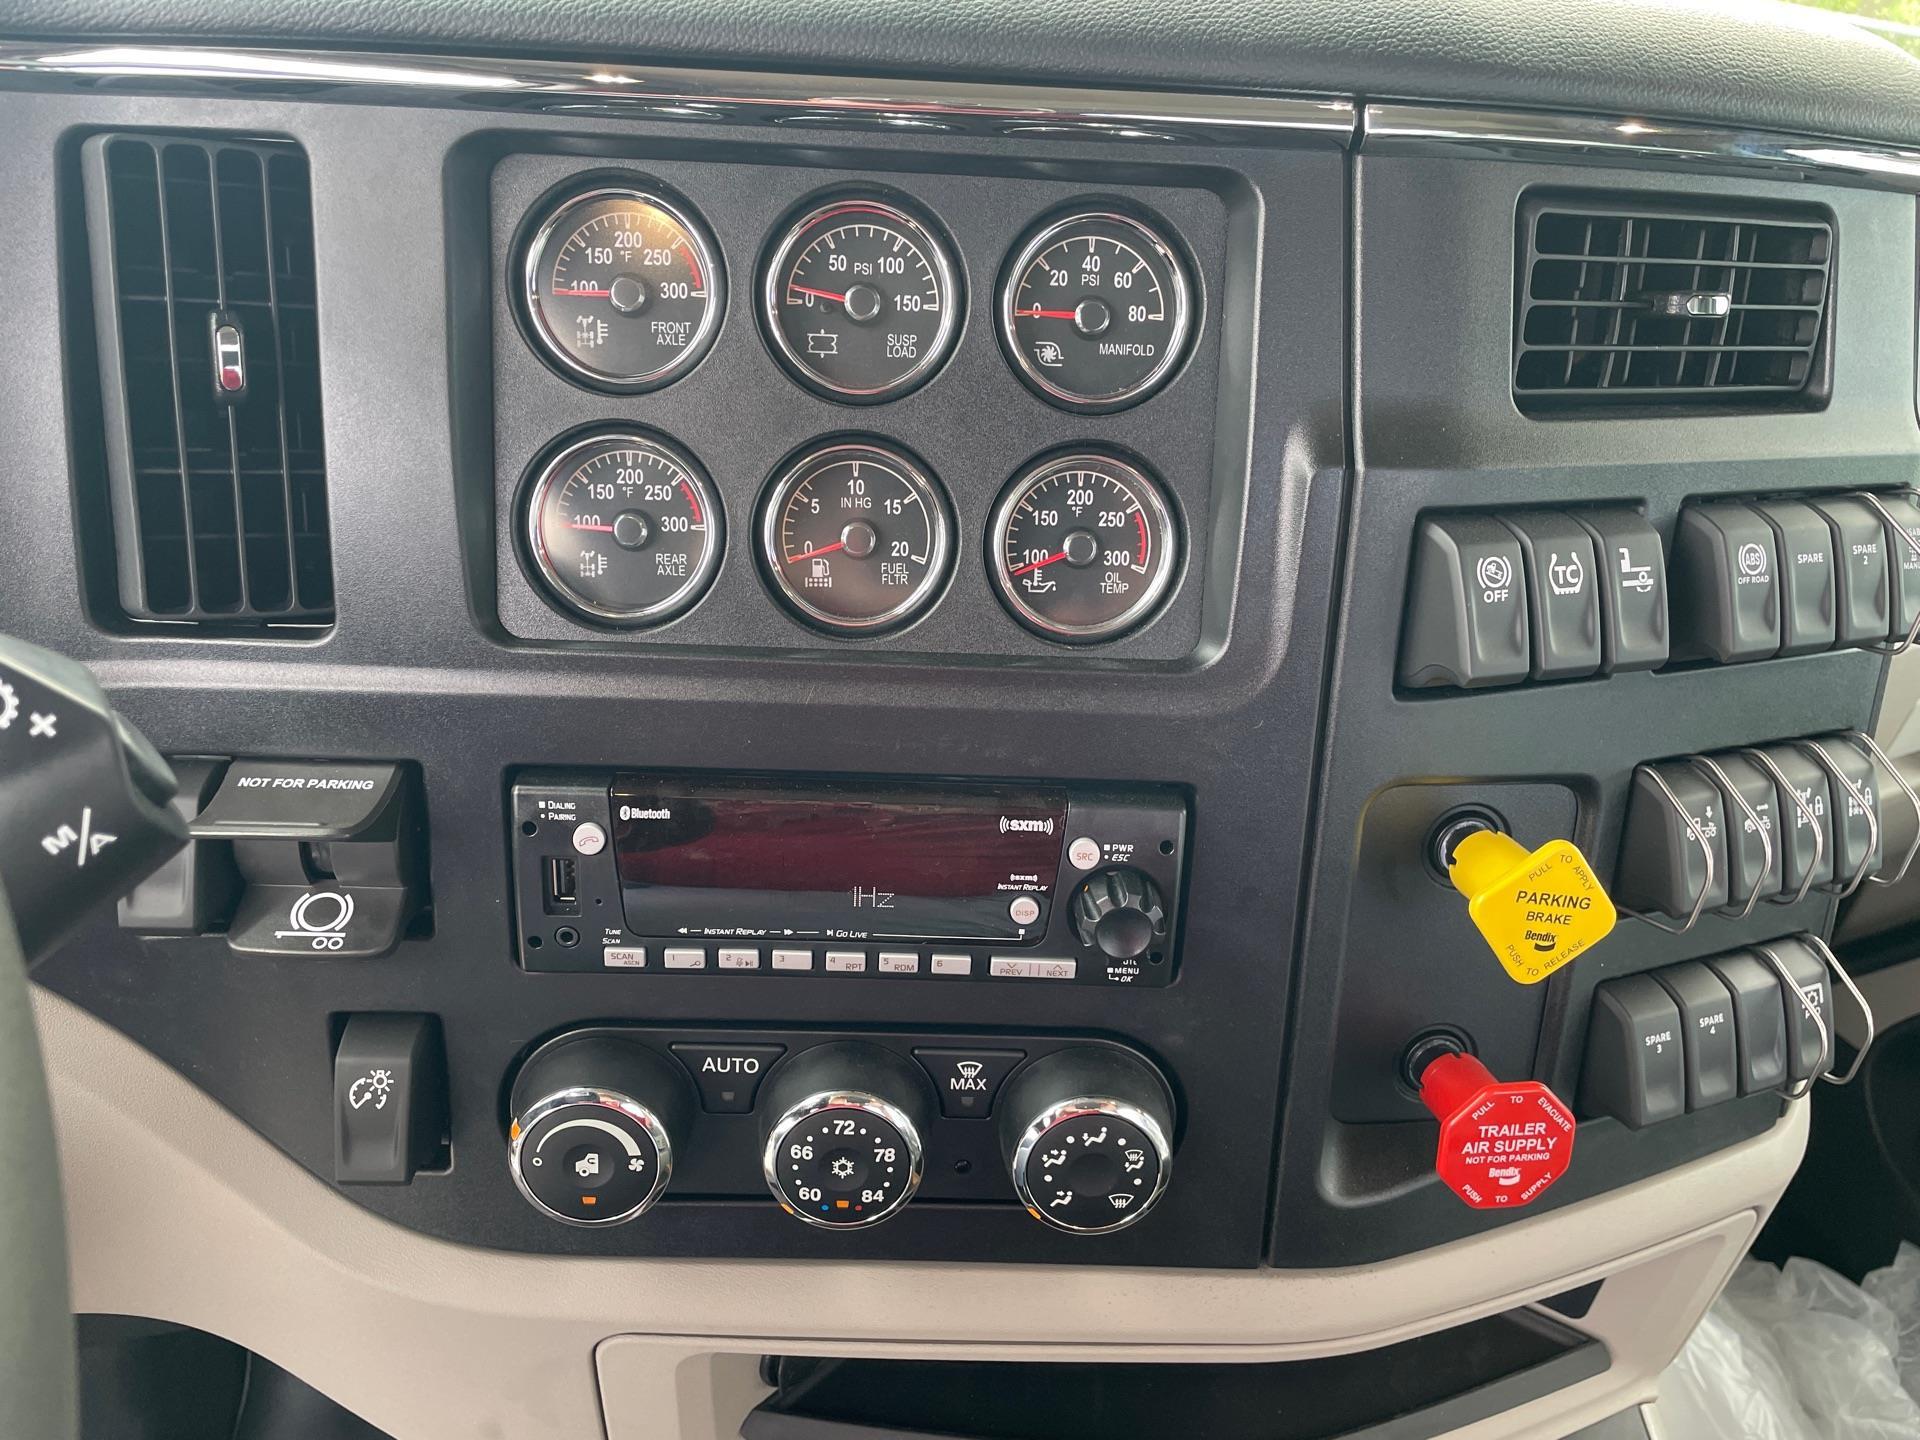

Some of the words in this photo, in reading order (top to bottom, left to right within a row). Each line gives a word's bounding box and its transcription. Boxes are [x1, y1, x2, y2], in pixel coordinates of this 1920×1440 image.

[614, 231, 643, 248] 200
[585, 247, 612, 264] 150
[643, 250, 672, 266] 250
[828, 254, 847, 272] 50
[854, 263, 872, 276] PSI
[878, 257, 904, 274] 100
[1082, 256, 1100, 272] 40
[1050, 270, 1068, 286] 20
[1082, 276, 1100, 286] PSI
[1114, 272, 1132, 288] 60
[660, 282, 688, 299] 300
[894, 294, 920, 312] 150
[1032, 303, 1041, 318] 0
[1128, 306, 1146, 322] 80
[651, 321, 691, 335] FRONT
[656, 334, 686, 346] AXLE
[887, 334, 917, 347] SUSP
[886, 346, 916, 358] LOAD
[1100, 344, 1154, 356] MANIFOLD
[616, 468, 644, 485] 200
[588, 484, 614, 500] 150
[644, 484, 672, 501] 250
[848, 479, 865, 495] 10
[840, 497, 852, 508] IN
[854, 497, 872, 508] HG
[1067, 490, 1094, 505] 200
[811, 499, 820, 514] 5
[884, 500, 902, 515] 15
[661, 517, 688, 532] 300
[1032, 511, 1058, 526] 150
[1098, 512, 1124, 527] 250
[891, 541, 909, 557] 20
[1852, 544, 1876, 554] SPARE
[656, 554, 687, 566] REAR
[1024, 550, 1048, 564] 100
[1104, 550, 1130, 566] 300
[1746, 552, 1760, 566] ABS
[1798, 554, 1824, 564] SPARE
[1864, 556, 1868, 565] 2
[657, 564, 686, 576] AXLE
[882, 563, 908, 575] FUEL
[1554, 565, 1579, 584] TC
[882, 574, 908, 585] FLTR
[1105, 572, 1121, 582] OIL
[1738, 577, 1750, 585] OFF
[1752, 576, 1769, 584] ROAD
[1100, 582, 1128, 594] TEMP
[1484, 590, 1508, 603] OFF
[238, 777, 269, 788] NOT
[272, 778, 306, 789] FOR
[307, 778, 374, 790] PARKING
[548, 802, 576, 810] DIALING
[548, 813, 576, 821] PAIRING
[631, 808, 670, 820] Bluetooth
[1112, 844, 1134, 852] PWR
[1076, 852, 1094, 862] SRC
[1112, 854, 1130, 862] ESC
[1528, 864, 1552, 882] PULL
[1560, 854, 1572, 864] TO
[1573, 866, 1594, 891] APPLY
[1516, 890, 1591, 910] PARKING
[1526, 912, 1572, 925] BRAKE
[704, 927, 735, 935] INSTANT
[736, 928, 766, 936] REPLAY
[1525, 930, 1556, 942] Bendix
[611, 952, 634, 960] SCAN
[829, 956, 836, 964] 4
[1506, 944, 1524, 966] PUSH
[1526, 968, 1539, 976] TO
[1544, 940, 1586, 970] RELEASE
[894, 964, 914, 972] RDM
[1700, 1013, 1724, 1028] SPARE
[1710, 1026, 1716, 1035] 4
[1645, 1032, 1671, 1046] SPARE
[1656, 1044, 1662, 1054] 3
[702, 1058, 759, 1074] AUTO
[950, 1078, 986, 1091] MAX
[1472, 1100, 1495, 1120] PULL
[1510, 1096, 1524, 1104] TO
[1538, 1096, 1572, 1132] EVACUATE
[833, 1121, 854, 1135] 72
[1479, 1122, 1546, 1138] TRAILER
[1461, 1142, 1489, 1154] AIR
[1494, 1137, 1558, 1152] SUPPLY
[790, 1146, 813, 1160] 66
[874, 1148, 896, 1162] 78
[1465, 1156, 1484, 1164] NOT
[1488, 1155, 1506, 1163] FOR
[1509, 1152, 1550, 1162] PARKING
[1488, 1167, 1520, 1178] Bendix
[1462, 1184, 1482, 1202] PUSH
[1520, 1172, 1552, 1200] SUPPLY
[798, 1188, 821, 1201] 60
[862, 1190, 884, 1202] 84
